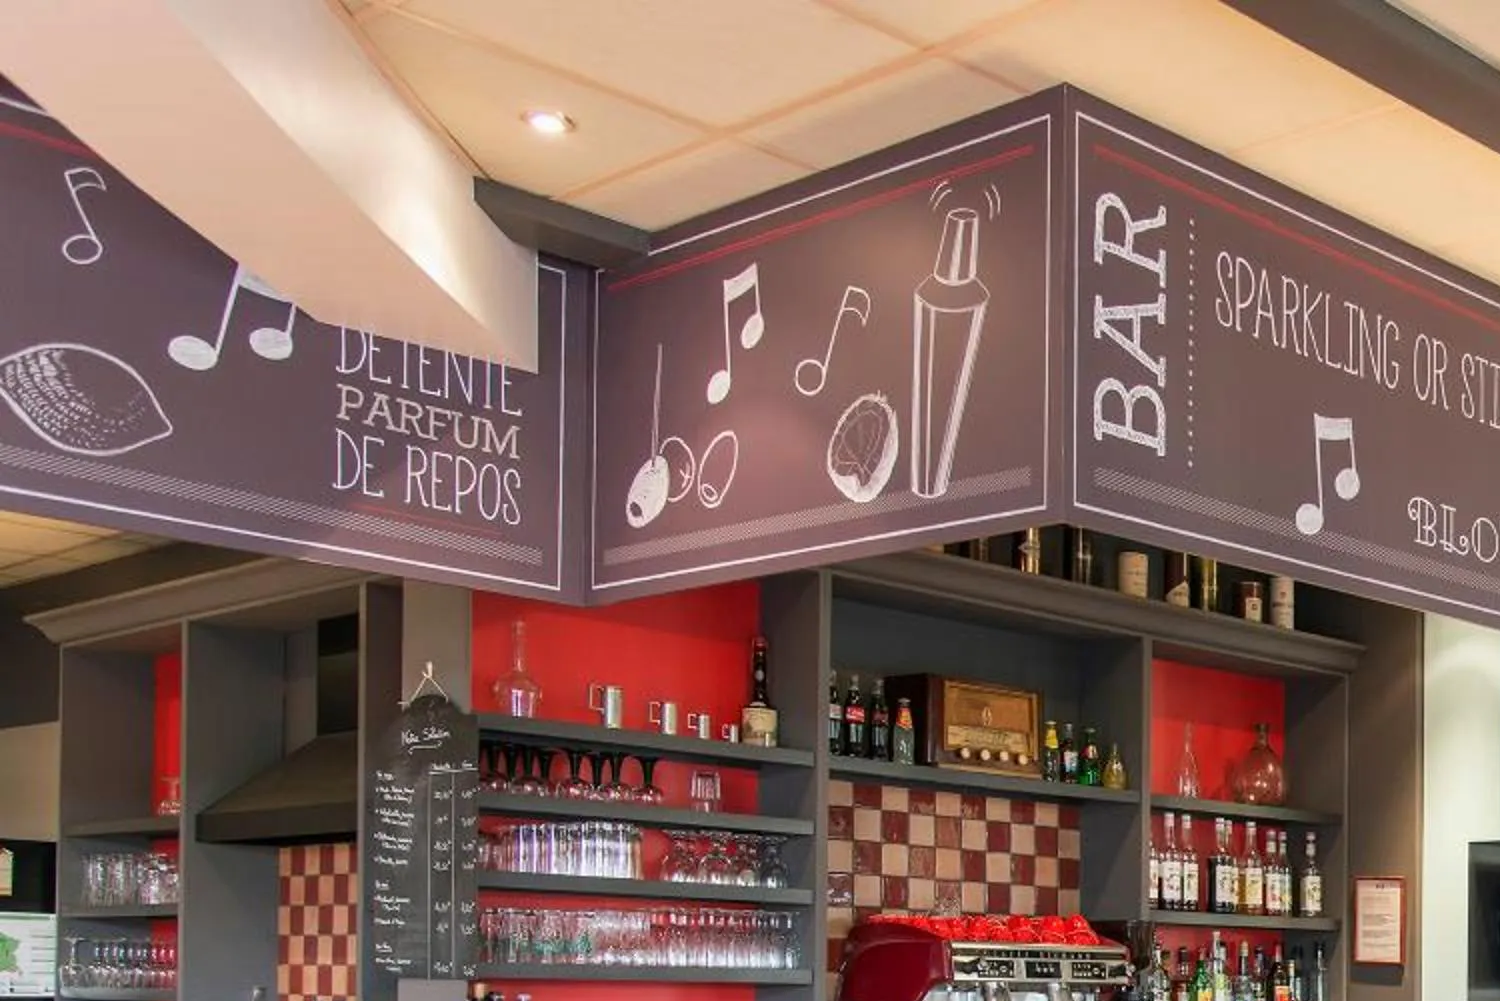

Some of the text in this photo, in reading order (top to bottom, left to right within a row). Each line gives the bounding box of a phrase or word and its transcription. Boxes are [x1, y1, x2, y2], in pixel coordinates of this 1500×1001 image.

[1094, 192, 1167, 457] BAR
[1214, 250, 1400, 391] SPARKLING
[1412, 333, 1450, 411] OR
[332, 428, 522, 526] DE REPOS
[336, 383, 521, 460] PARFUM
